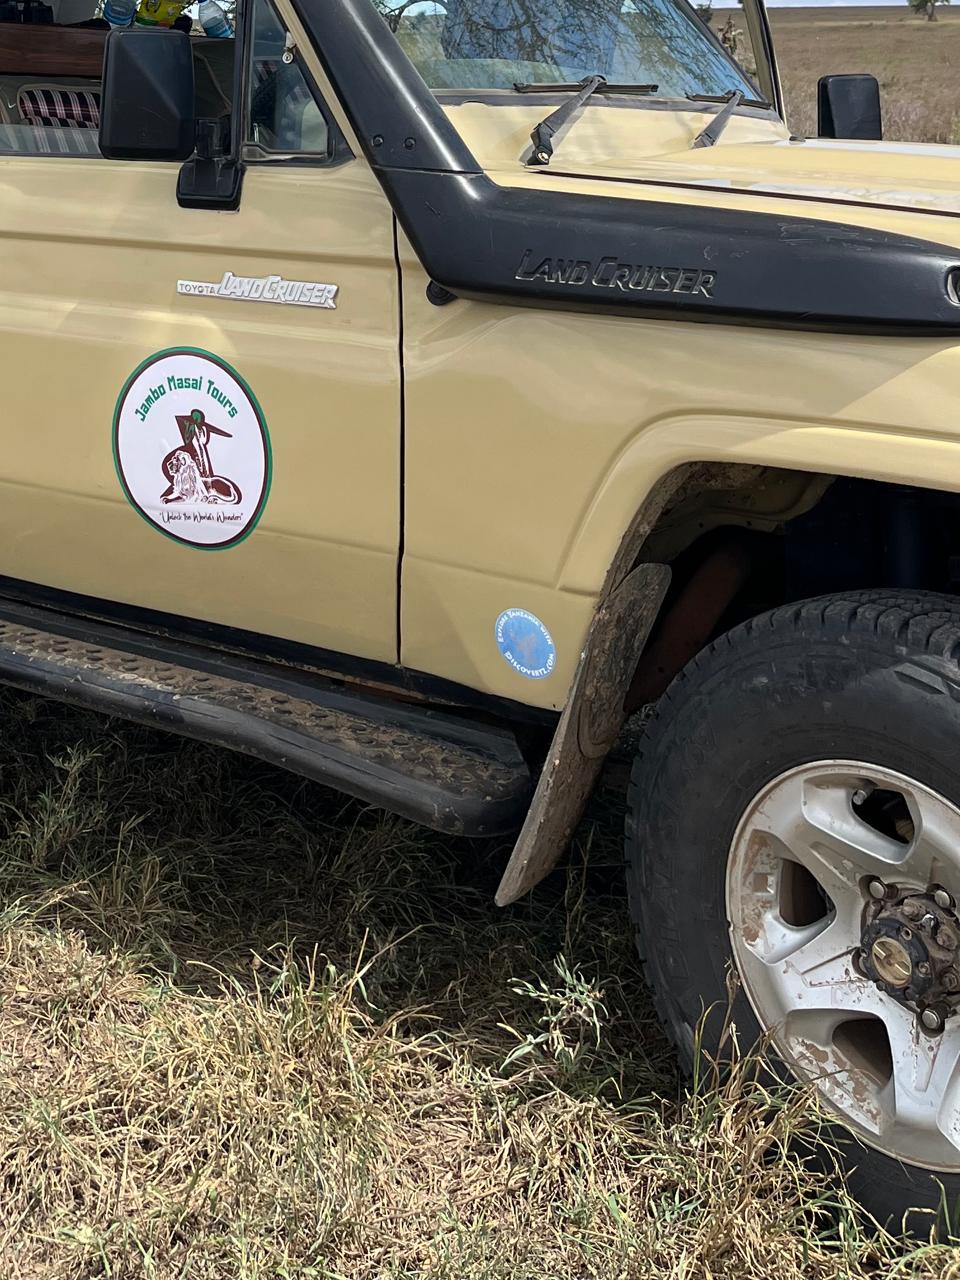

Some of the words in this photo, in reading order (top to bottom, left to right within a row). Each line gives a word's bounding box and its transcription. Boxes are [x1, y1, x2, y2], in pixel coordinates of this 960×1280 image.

[178, 283, 216, 294] TOYOTA
[134, 384, 167, 422] Jambo
[167, 375, 203, 391] Masai
[206, 378, 238, 418] Tours
